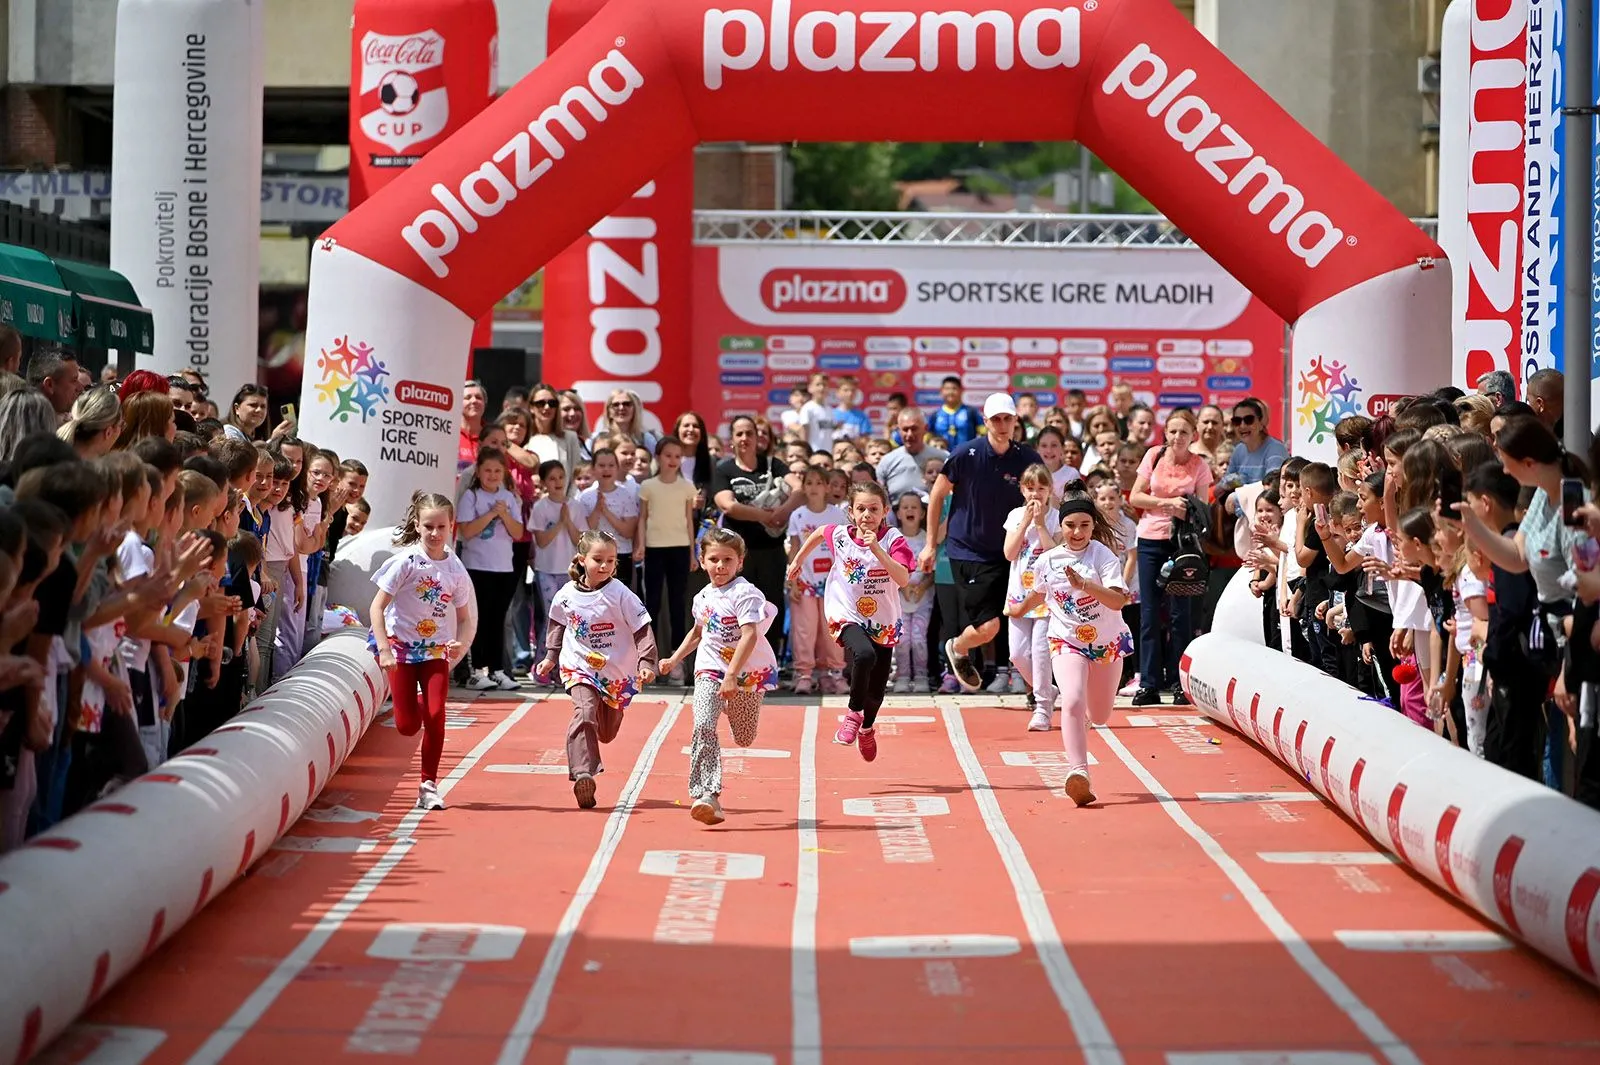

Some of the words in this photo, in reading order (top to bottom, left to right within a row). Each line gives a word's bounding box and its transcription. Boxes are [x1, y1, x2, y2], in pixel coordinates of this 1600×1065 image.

[703, 0, 1081, 90] plazma
[1529, 7, 1543, 146] HERZE
[184, 34, 212, 171] Hercegovine
[378, 123, 423, 137] CUP
[401, 49, 644, 278] plazma
[1102, 43, 1343, 268] plazma
[185, 191, 209, 258] Bosne
[260, 180, 346, 209] STOR
[1527, 161, 1541, 249] AND
[156, 190, 177, 289] Pokrovitelj
[772, 273, 889, 308] plazma
[916, 281, 1044, 304] SPORTSKE
[1051, 282, 1107, 304] IGRE
[1115, 283, 1214, 305] MLADIH
[1525, 258, 1541, 385] OSNIA
[382, 410, 452, 435] SPORTSKE
[401, 385, 449, 405] plazma
[380, 447, 439, 468] MLADIH
[381, 428, 418, 446] IGRE
